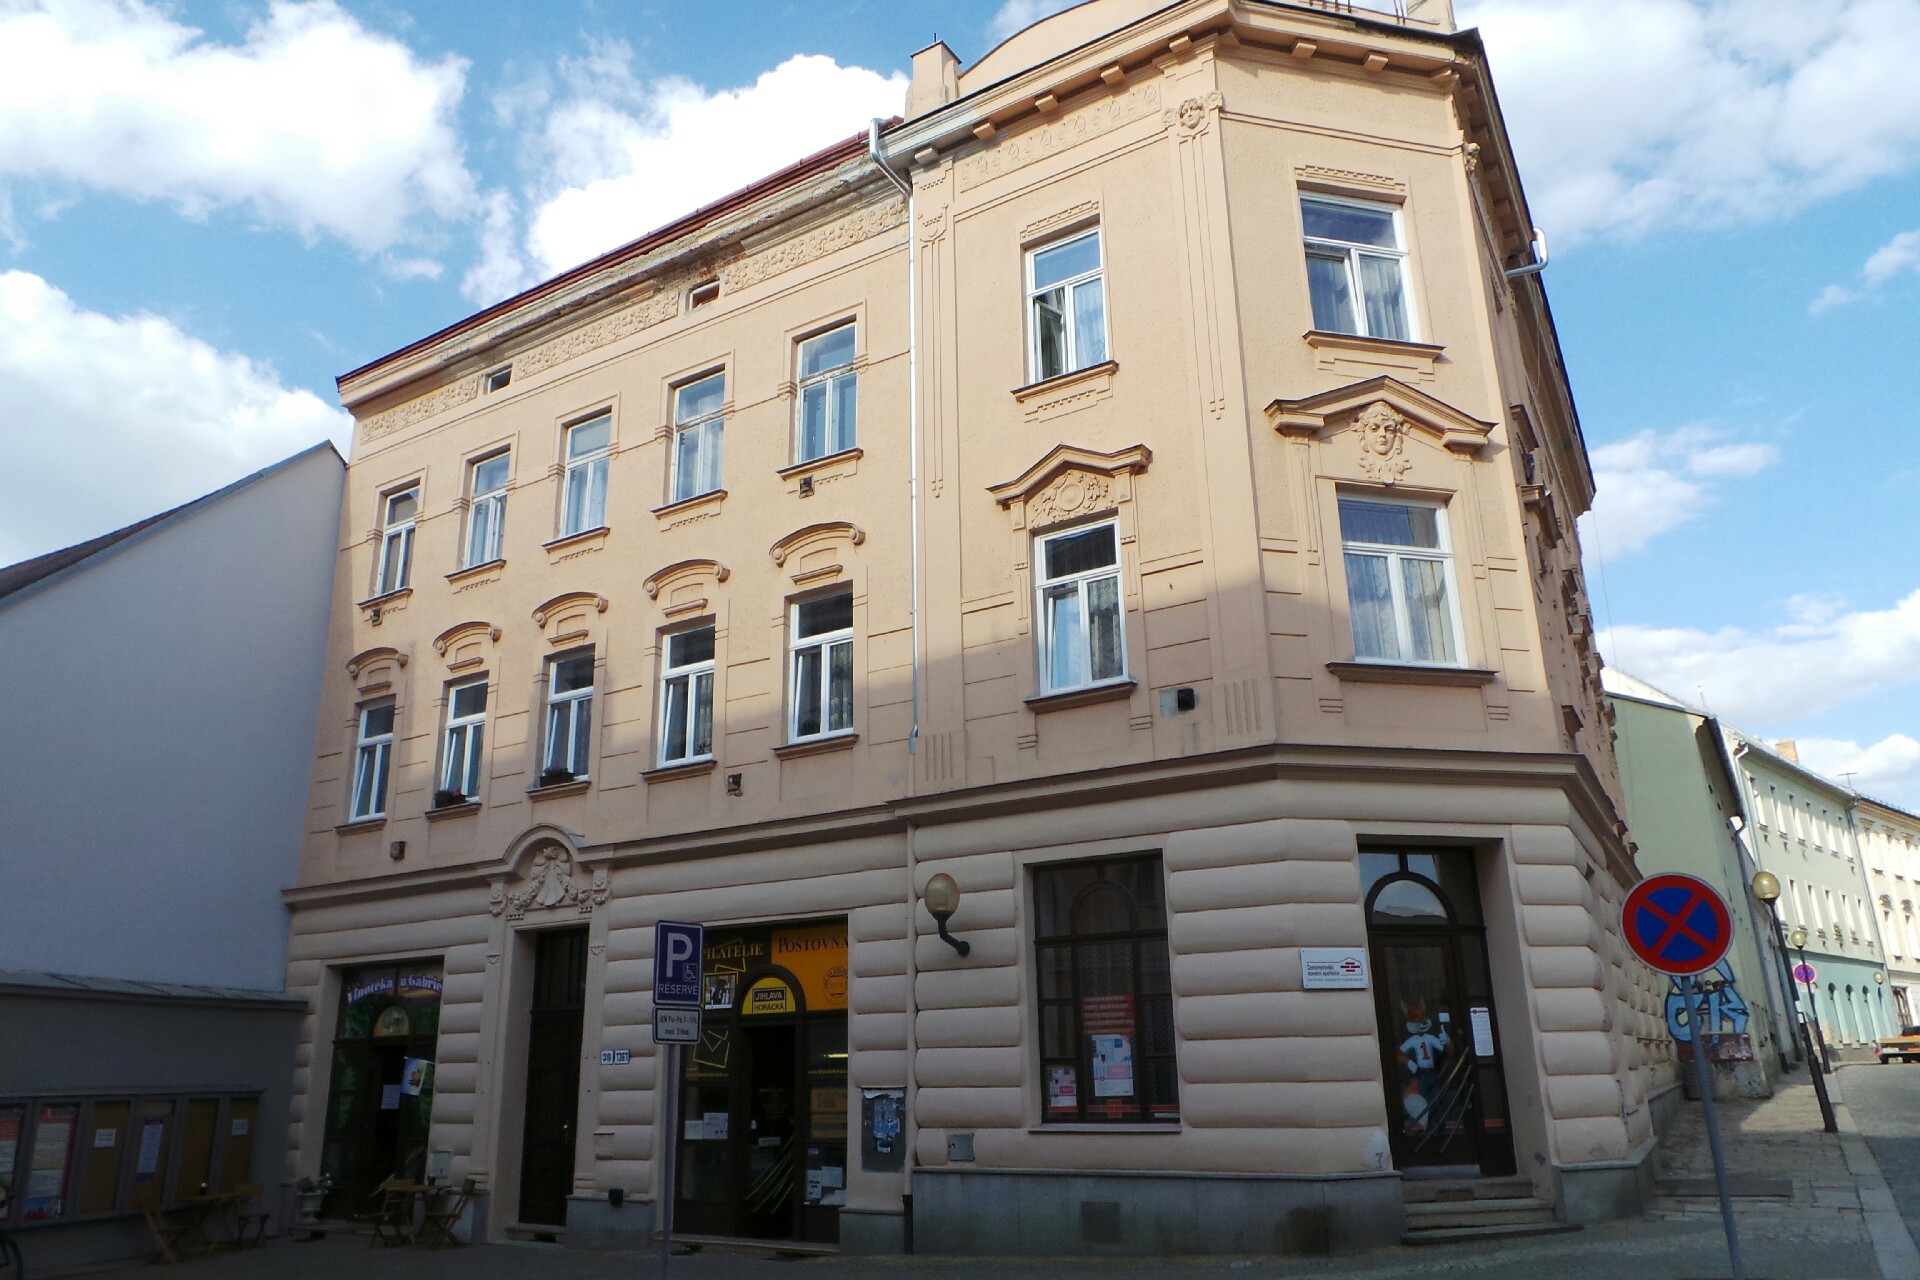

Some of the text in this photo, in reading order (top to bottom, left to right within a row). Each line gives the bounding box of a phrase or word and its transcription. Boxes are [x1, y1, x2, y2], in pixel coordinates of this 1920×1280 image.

[666, 932, 693, 978] P
[755, 992, 783, 1001] JIHLAVA
[1420, 1041, 1431, 1060] 1
